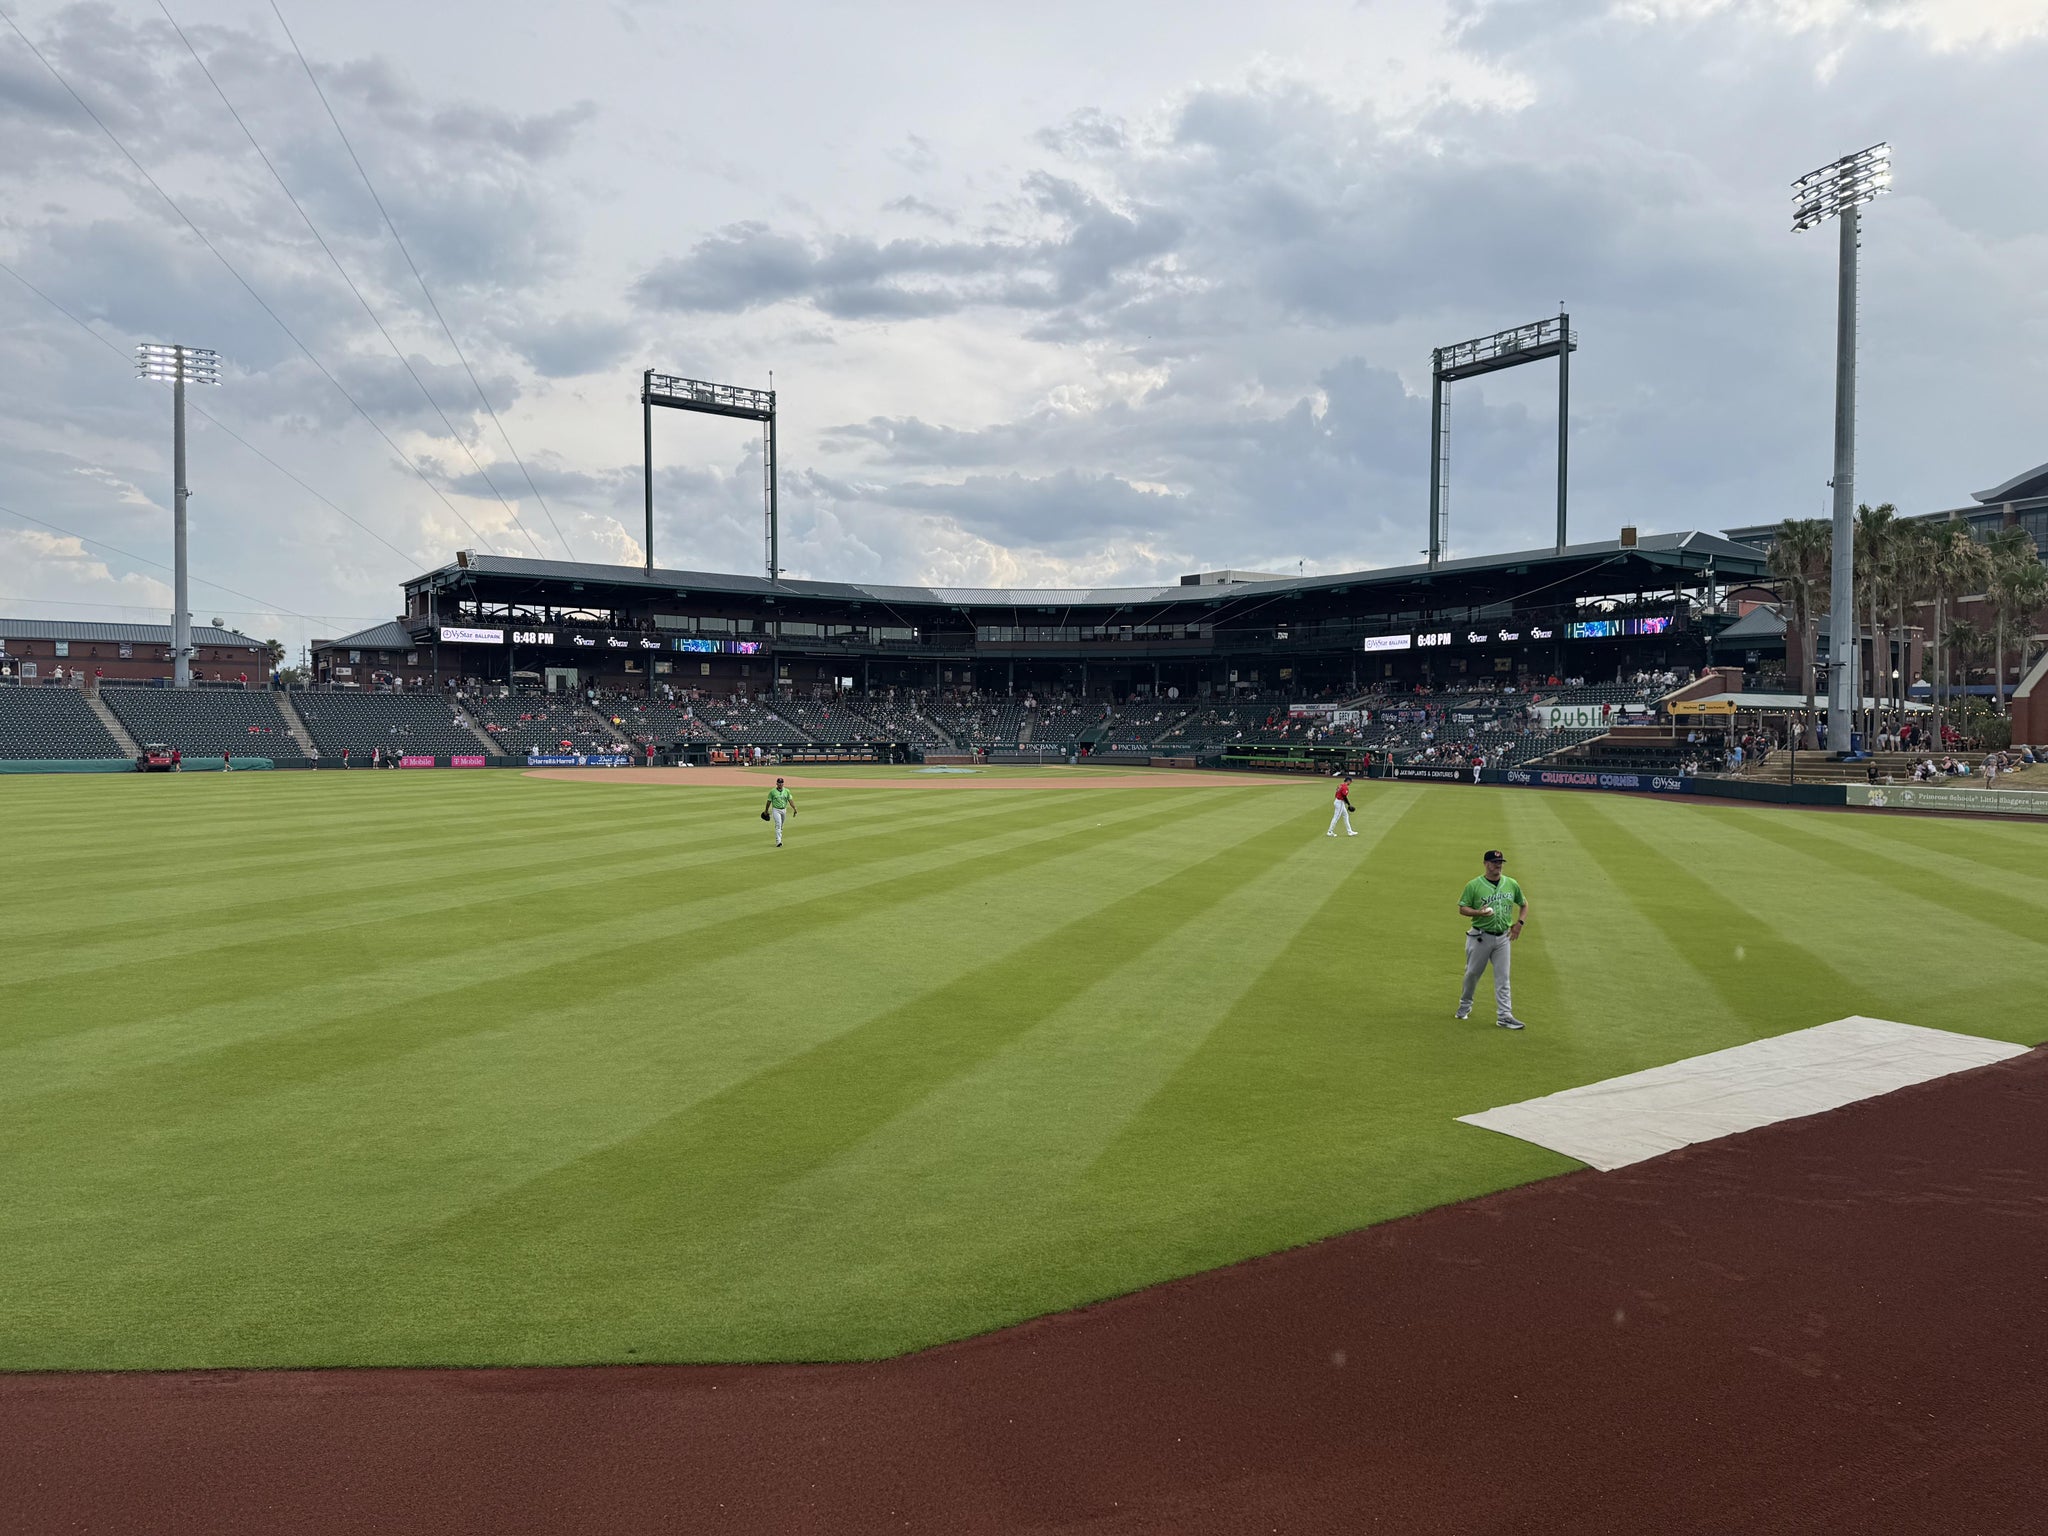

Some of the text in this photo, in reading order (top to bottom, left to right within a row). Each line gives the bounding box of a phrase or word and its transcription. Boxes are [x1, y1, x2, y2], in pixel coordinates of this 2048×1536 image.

[513, 631, 554, 645] 6:48 PM
[1417, 633, 1437, 647] 6:48
[1437, 632, 1452, 646] PM
[1550, 706, 1615, 727] Publi
[409, 758, 432, 766] Mobile
[460, 758, 483, 766] Mobile
[1407, 769, 1427, 777] IMPLANTS
[1541, 772, 1640, 787] CRUSTACEAN CORNER
[1660, 777, 1681, 789] VyStar
[1999, 797, 2030, 805] Sluggers
